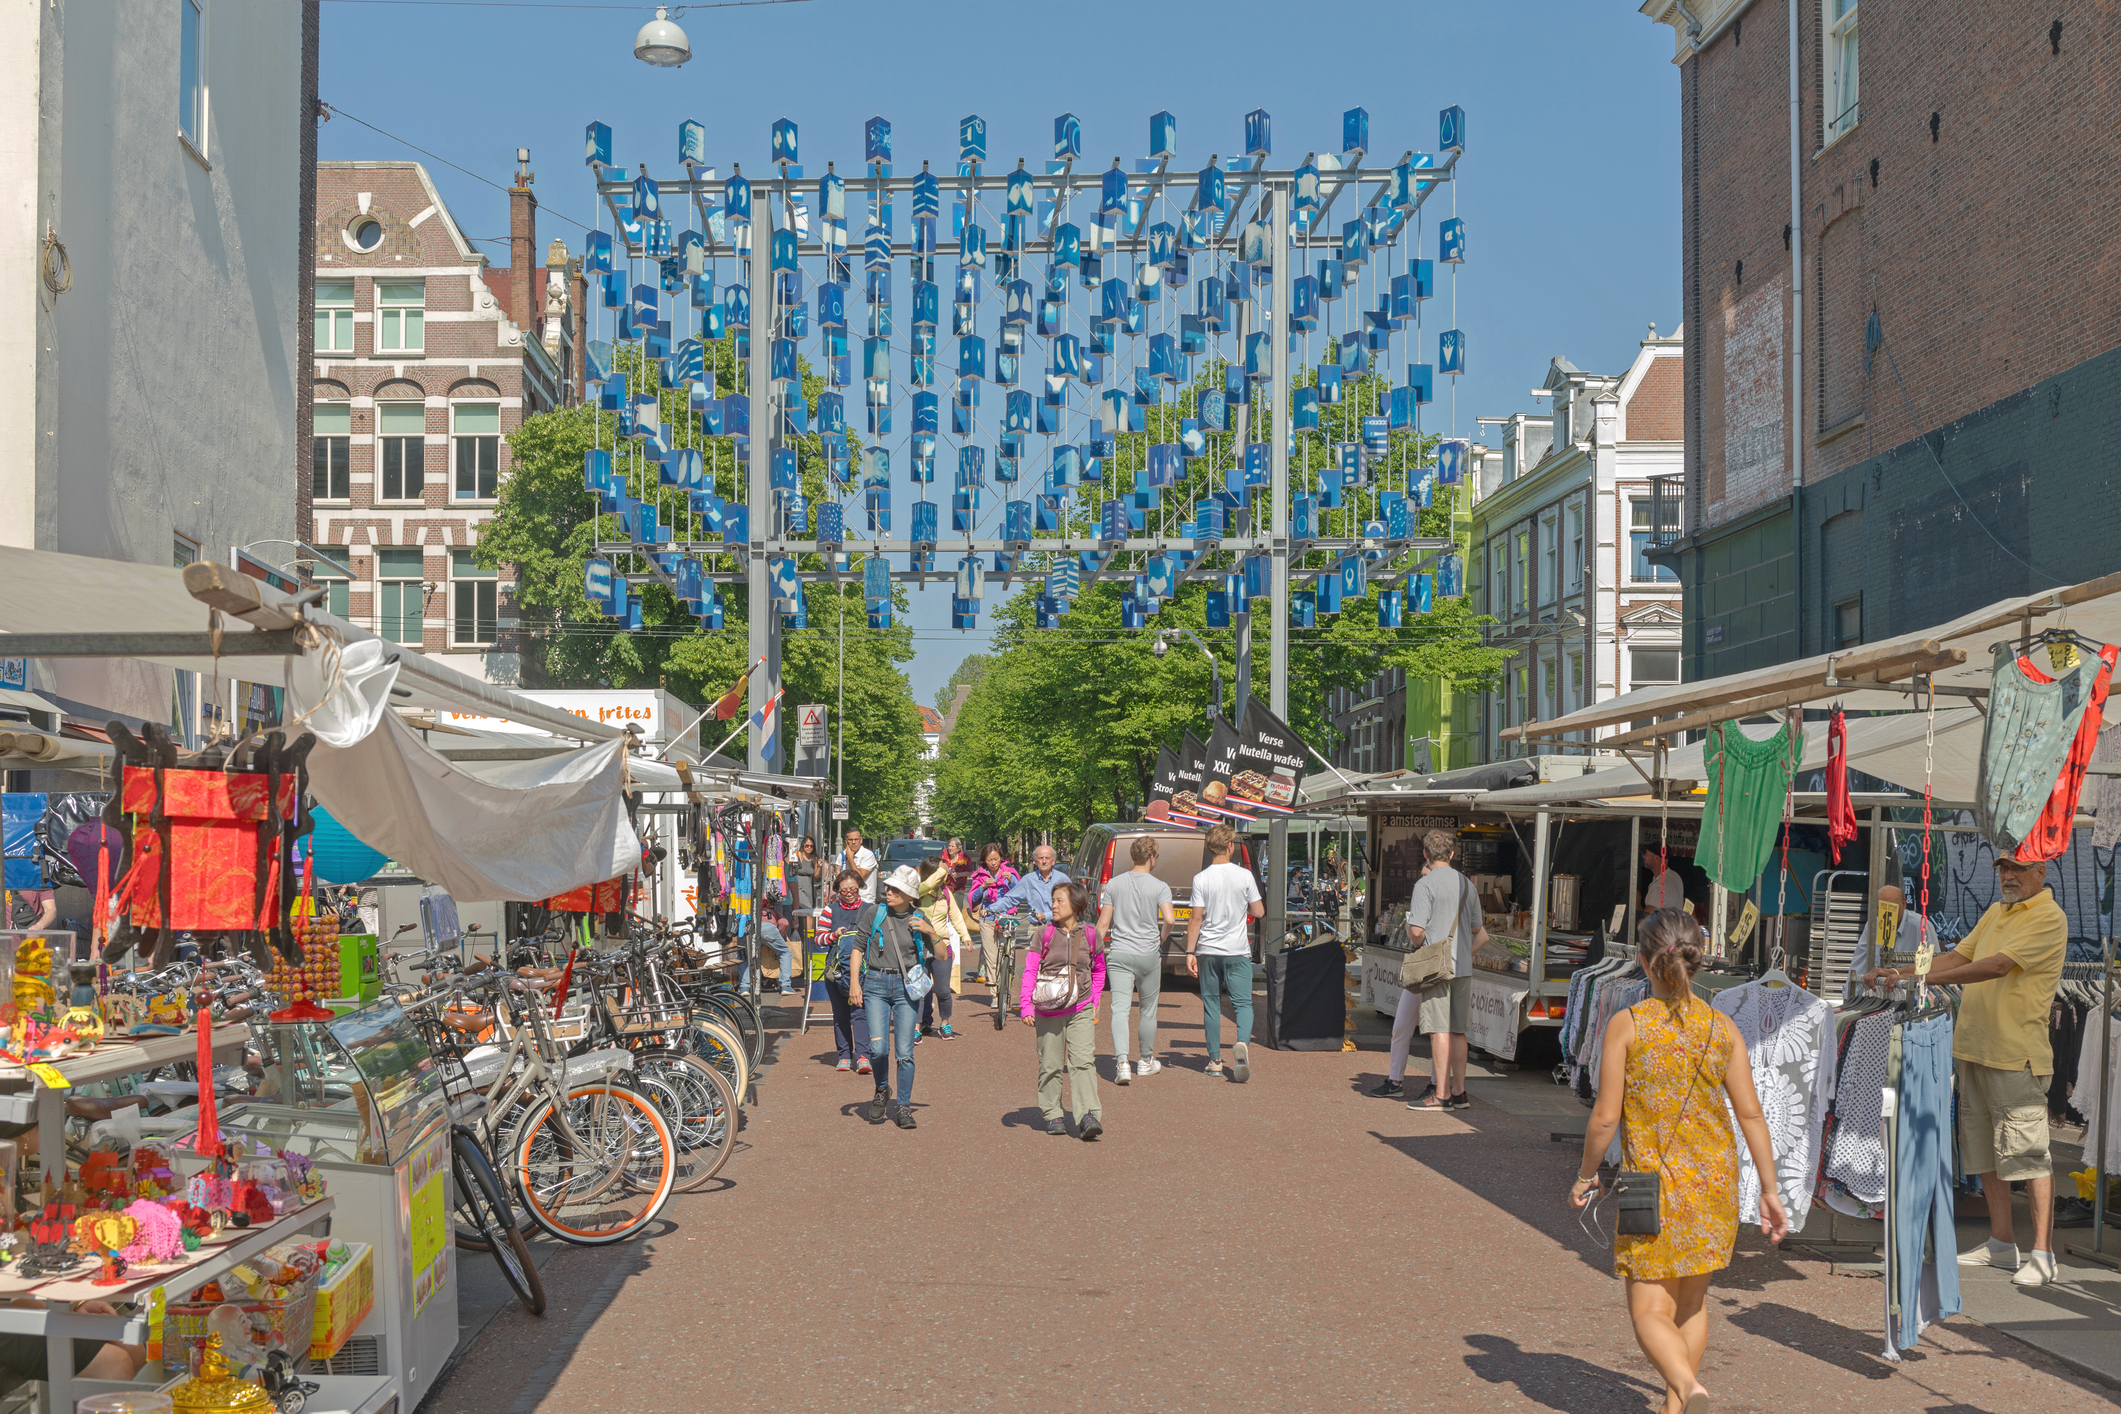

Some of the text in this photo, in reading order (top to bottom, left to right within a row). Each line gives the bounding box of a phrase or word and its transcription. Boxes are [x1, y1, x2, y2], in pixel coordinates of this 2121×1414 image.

[599, 705, 652, 723] frites
[1259, 731, 1284, 748] Verse
[1239, 744, 1304, 769] Nutella wafels
[1271, 783, 1291, 792] nutella
[1390, 814, 1455, 828] amsterdamse
